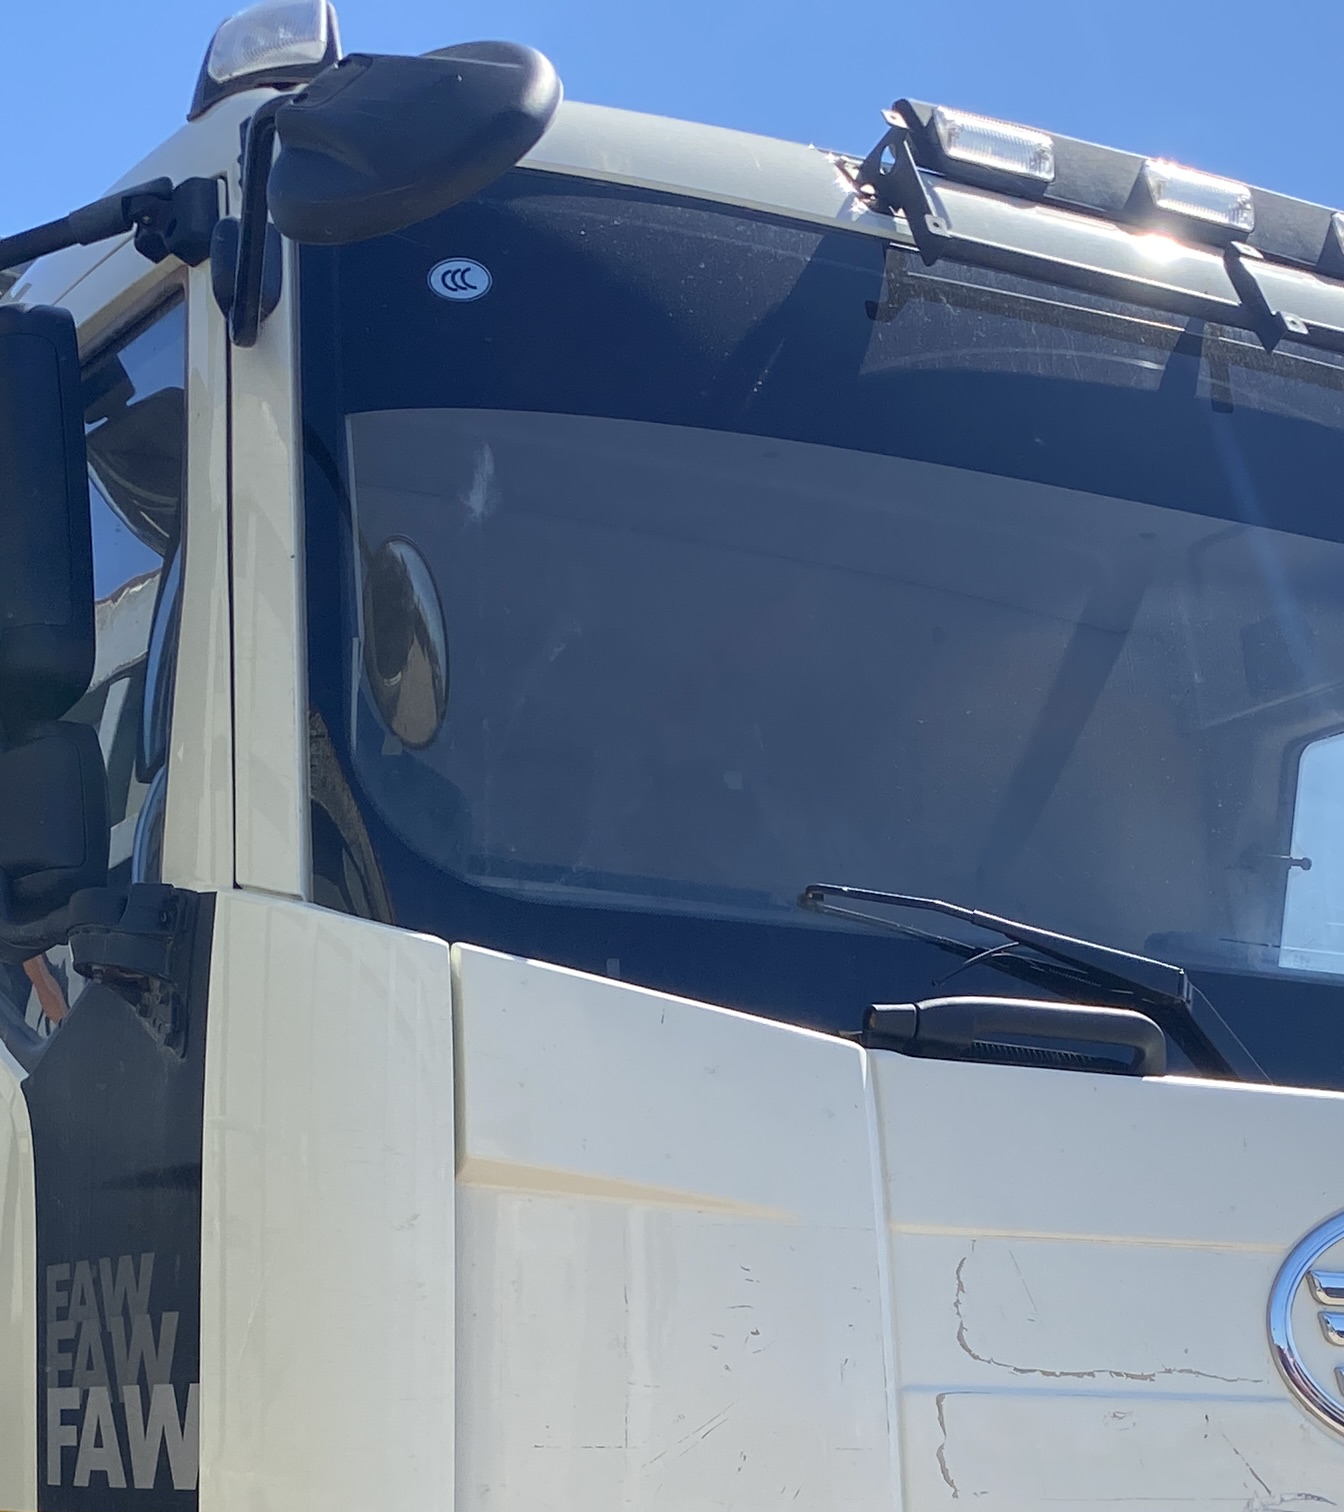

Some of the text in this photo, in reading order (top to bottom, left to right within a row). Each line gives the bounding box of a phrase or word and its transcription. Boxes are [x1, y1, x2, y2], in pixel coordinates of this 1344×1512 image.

[46, 1251, 156, 1332] FAW
[47, 1310, 180, 1403] FAW
[47, 1383, 200, 1491] FAW
